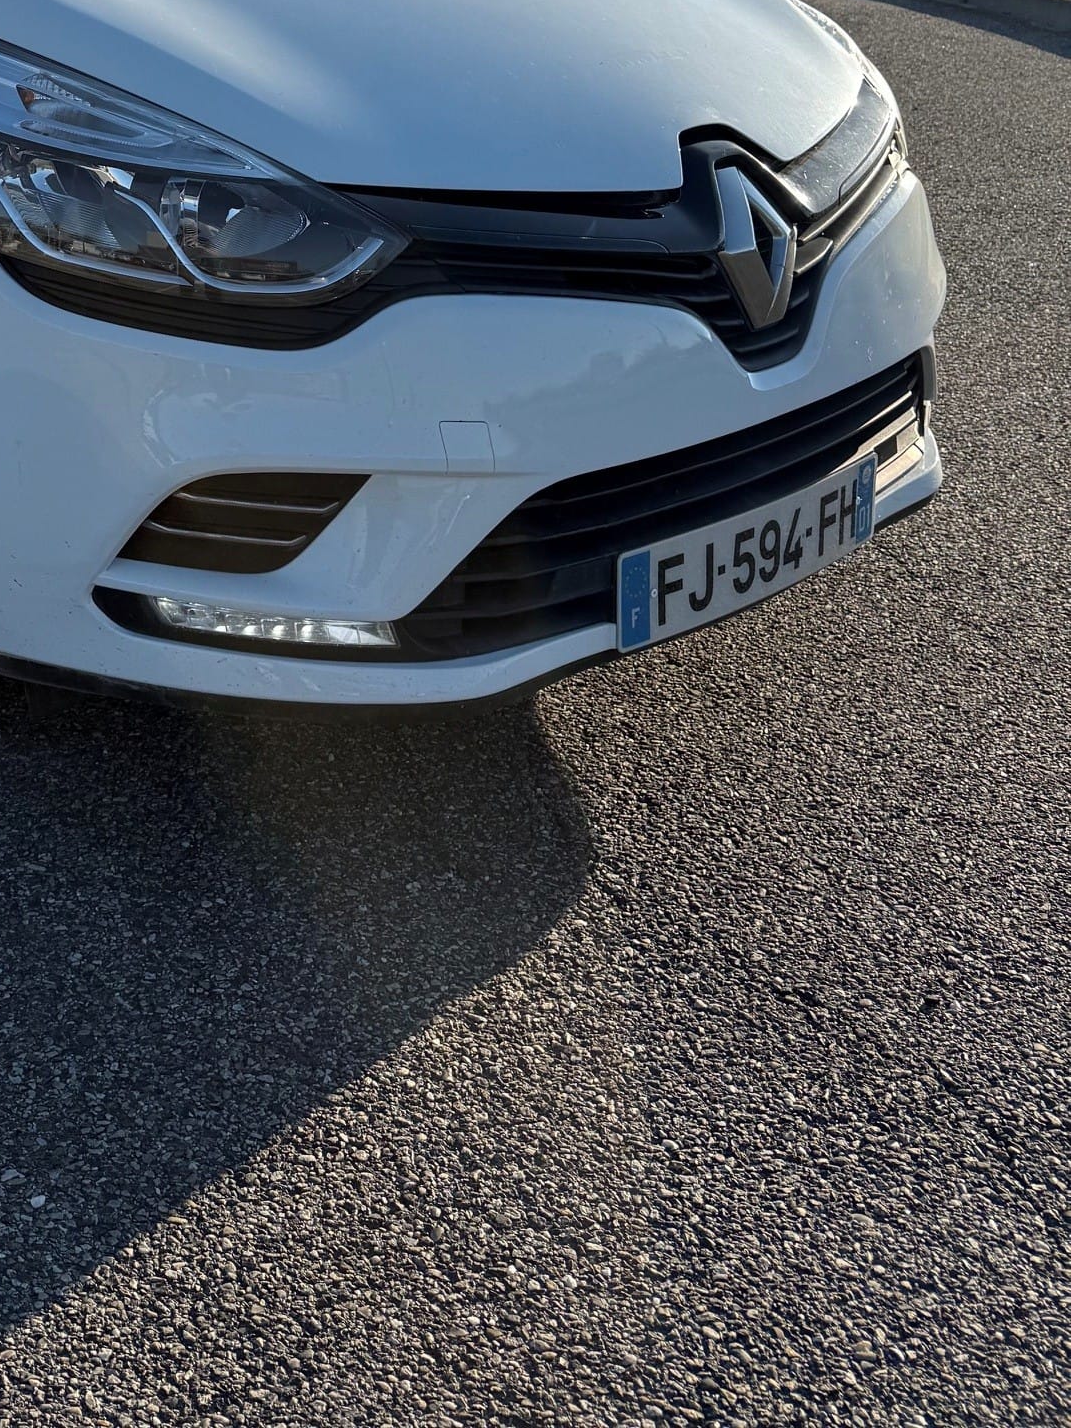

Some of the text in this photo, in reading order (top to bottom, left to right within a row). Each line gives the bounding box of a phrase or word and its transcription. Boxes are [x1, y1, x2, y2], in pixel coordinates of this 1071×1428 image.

[631, 478, 871, 628] F FJ-594-FH 01
